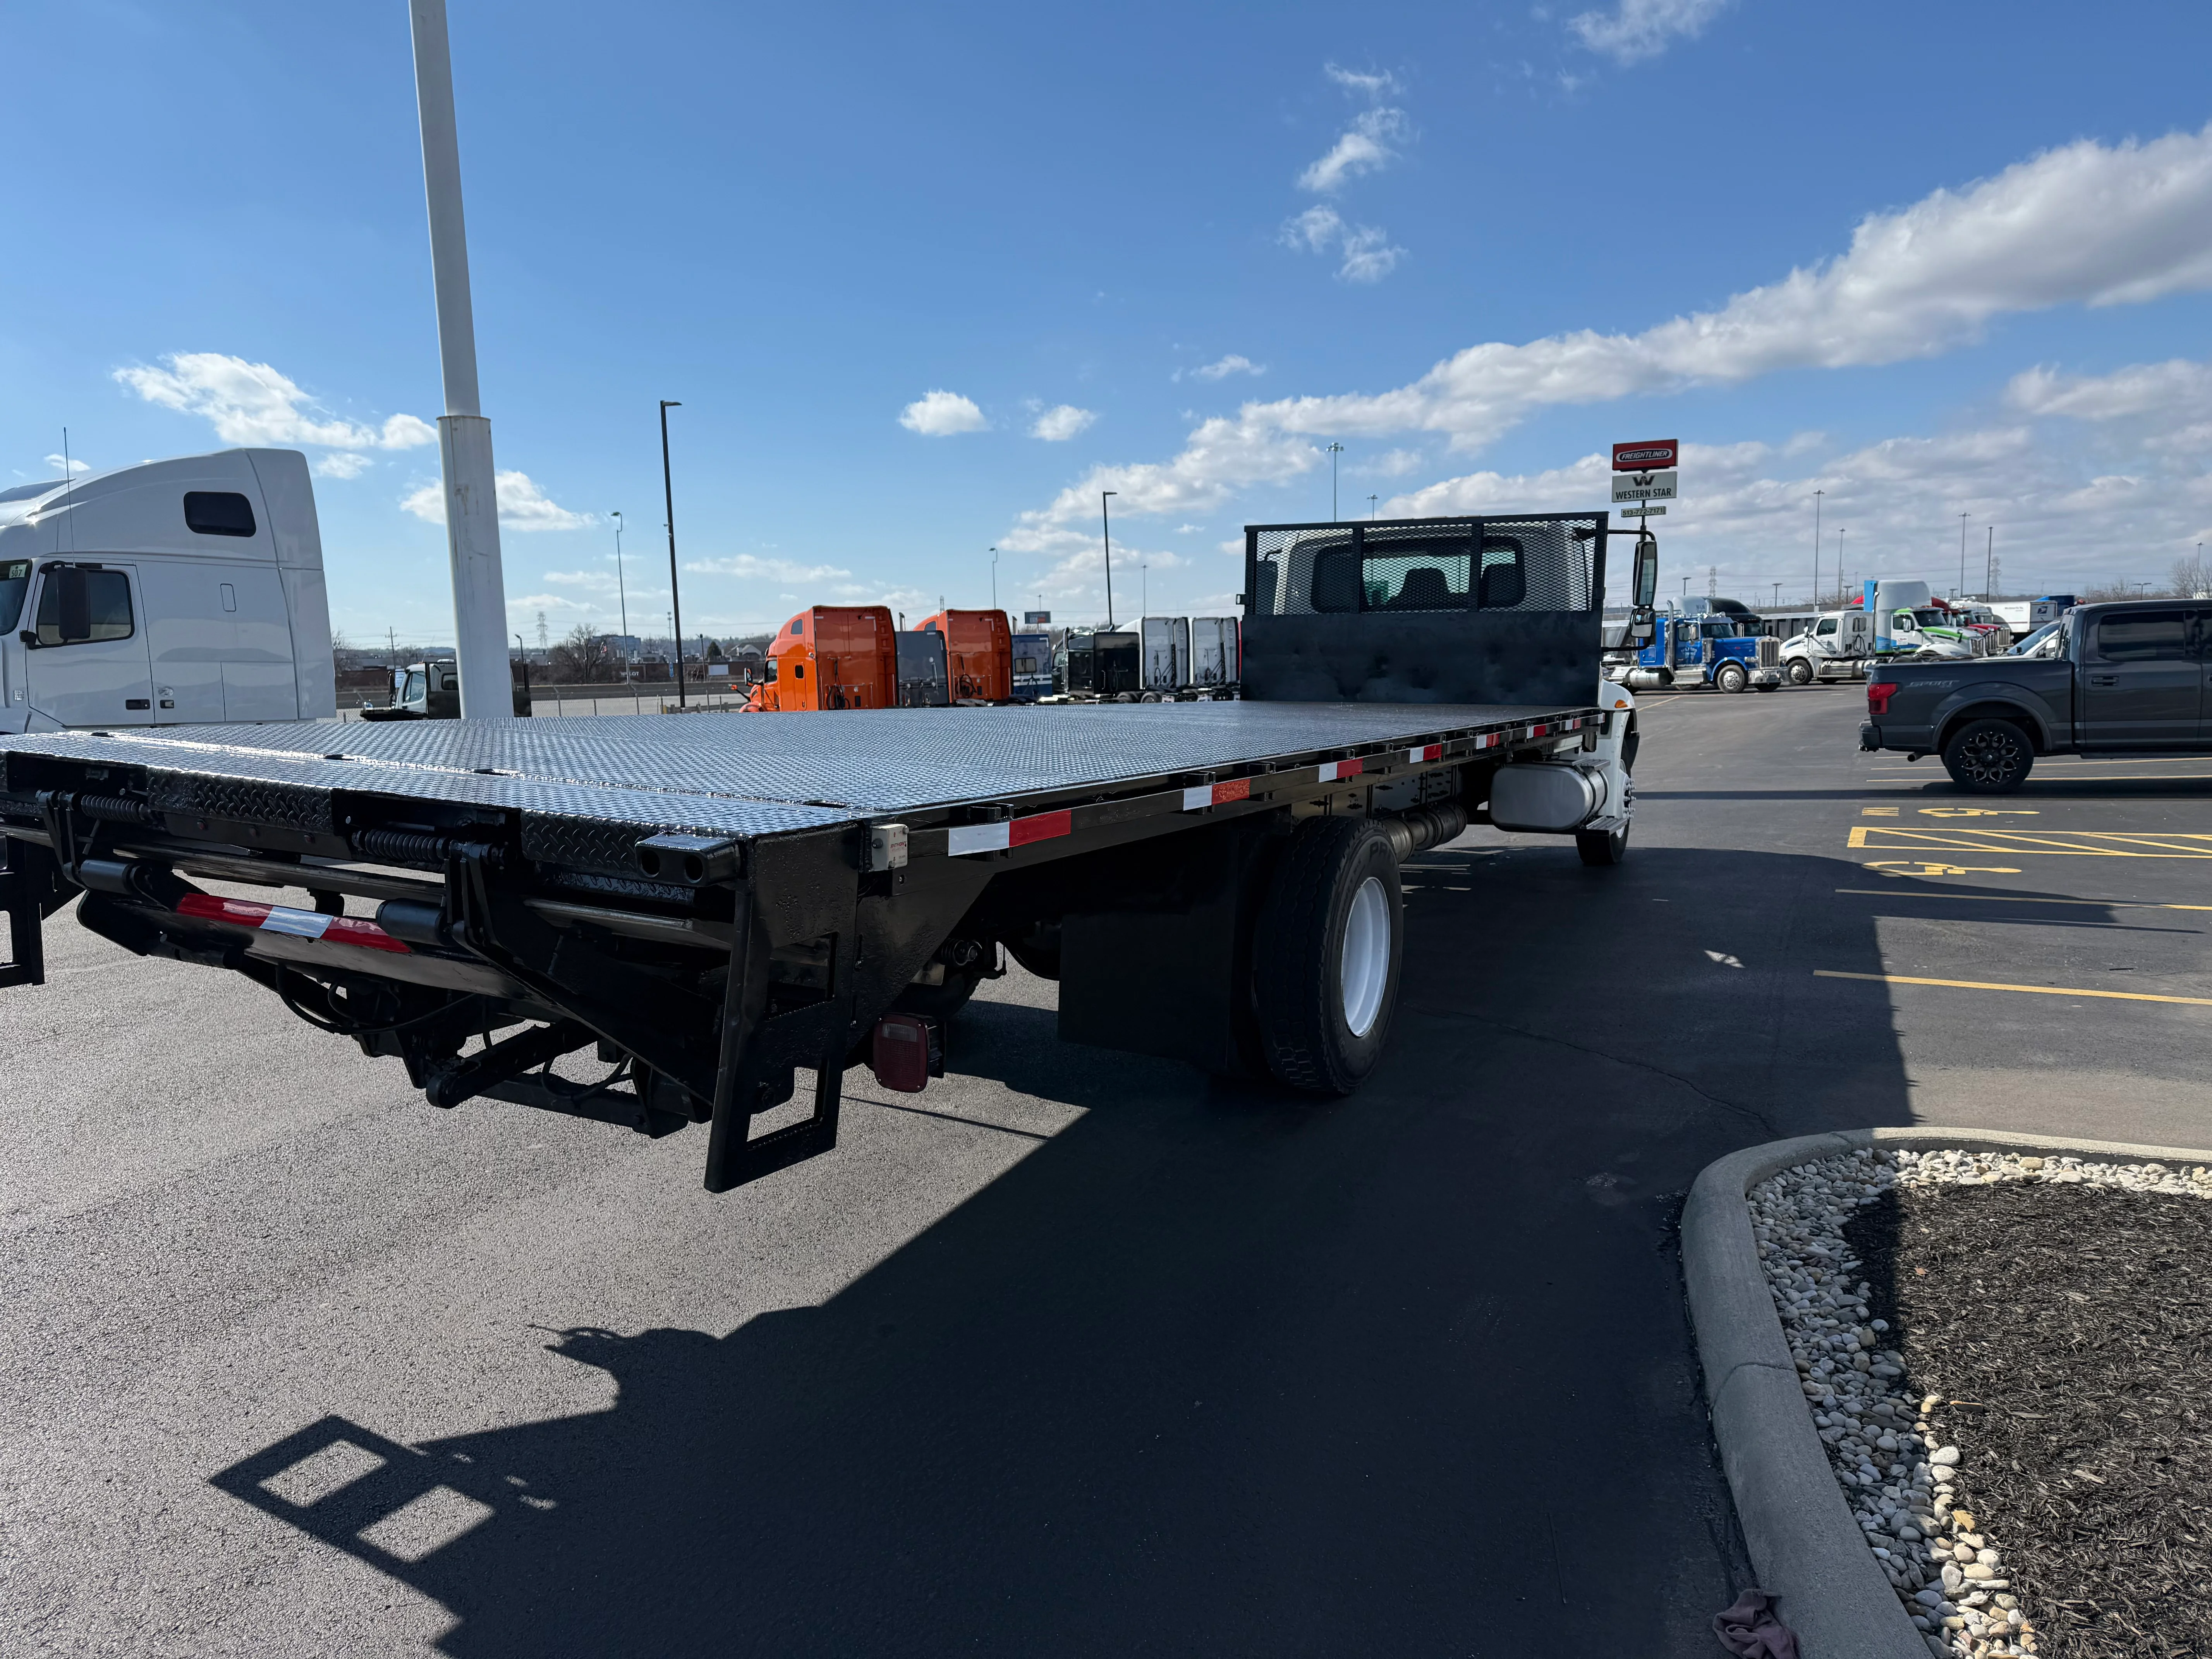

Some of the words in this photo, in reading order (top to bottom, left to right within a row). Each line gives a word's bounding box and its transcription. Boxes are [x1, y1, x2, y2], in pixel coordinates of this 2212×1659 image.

[1621, 451, 1668, 460] FREIGHTLINER
[1616, 489, 1650, 500] WESTERN
[1653, 488, 1671, 497] STAR
[11, 569, 22, 577] 507
